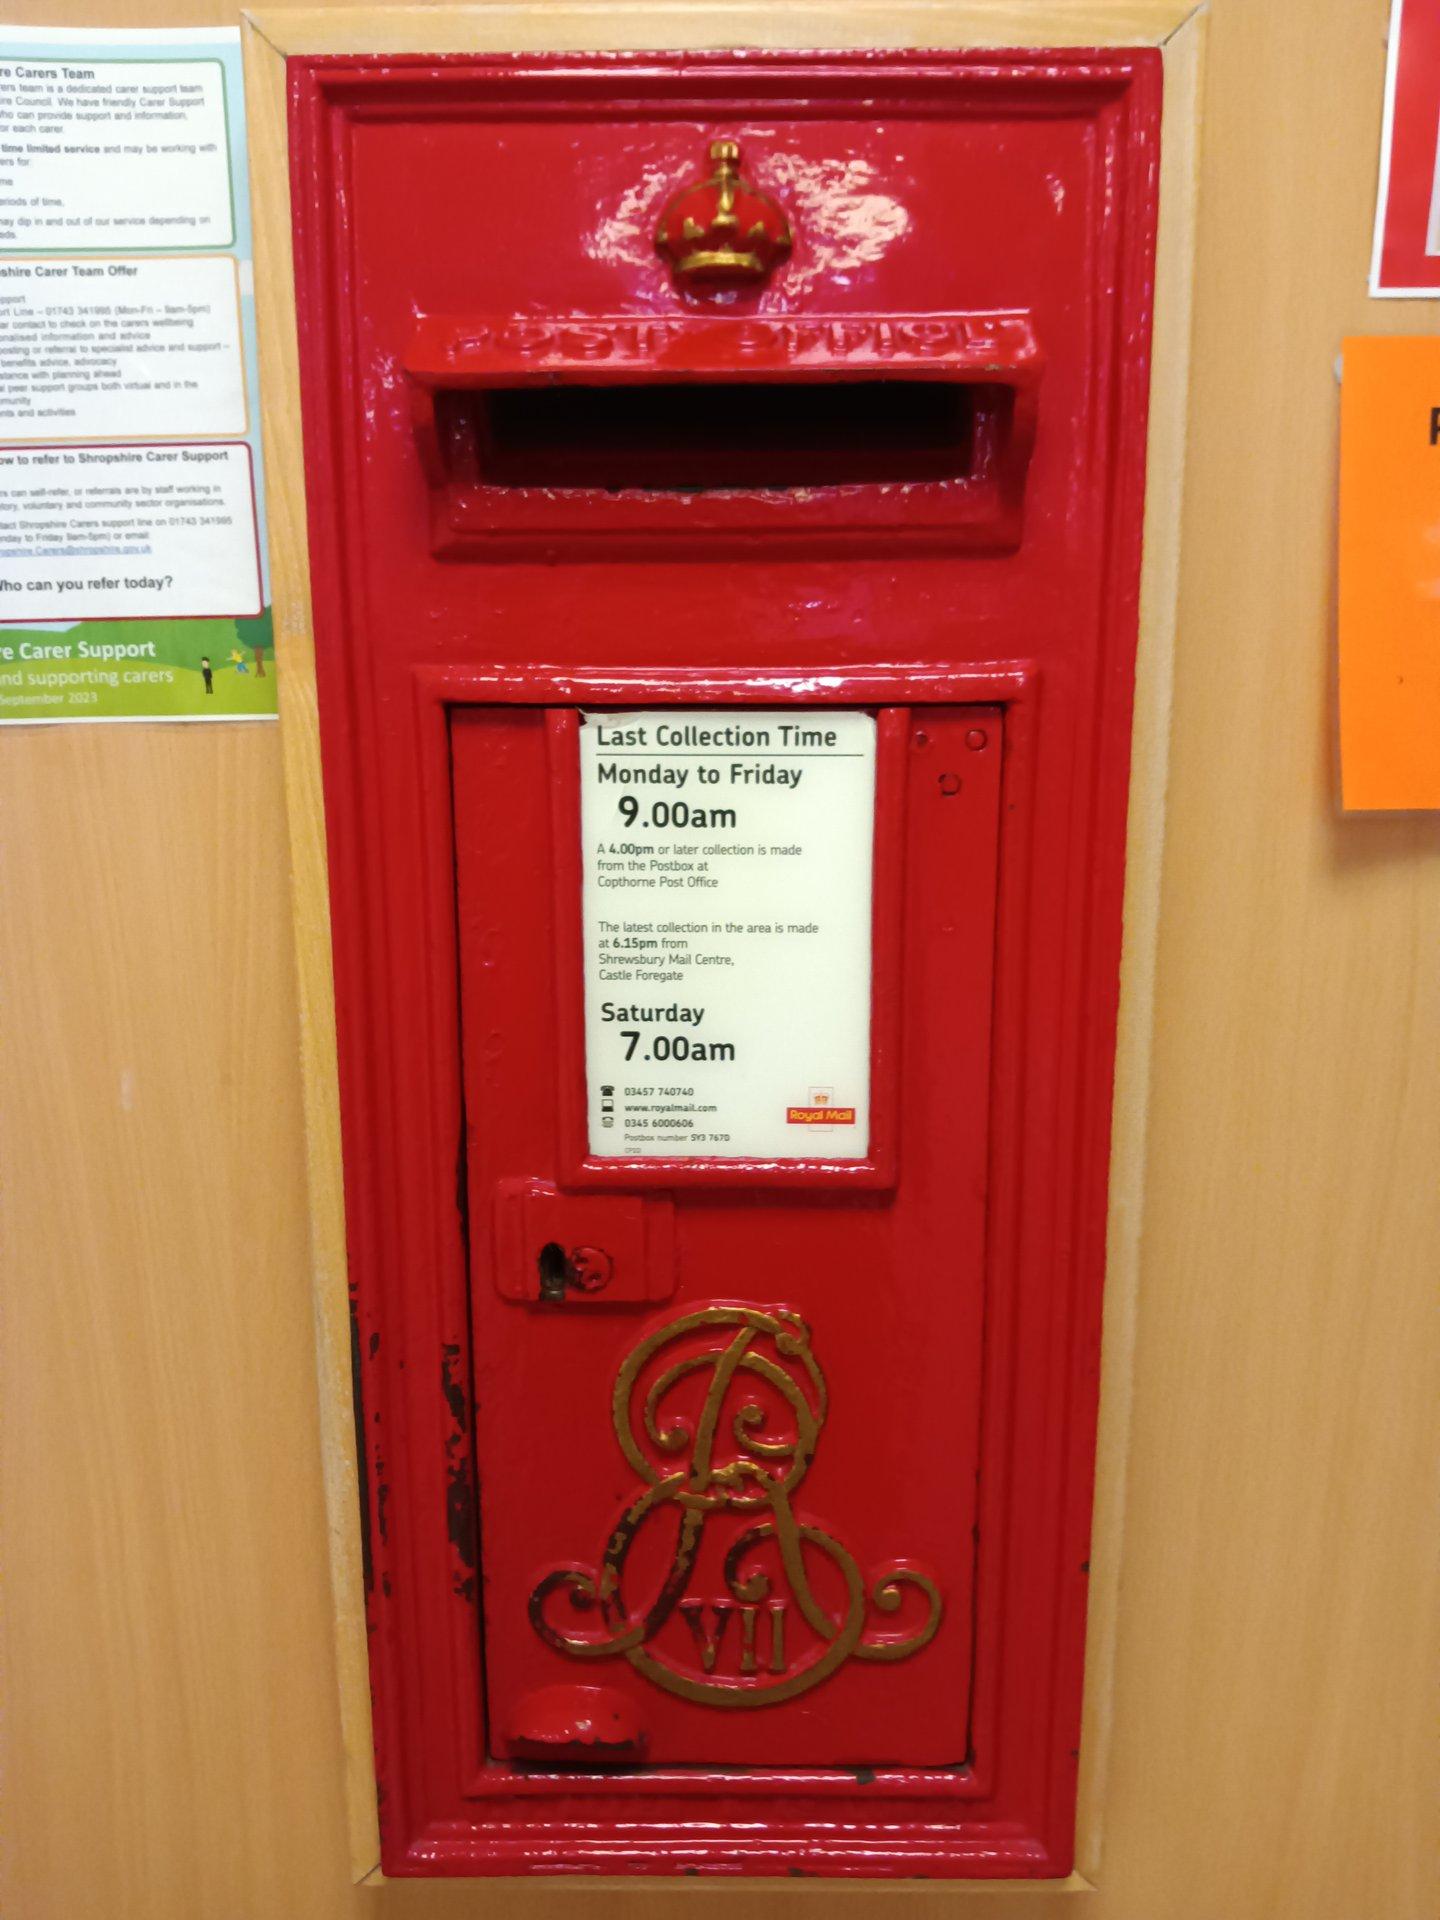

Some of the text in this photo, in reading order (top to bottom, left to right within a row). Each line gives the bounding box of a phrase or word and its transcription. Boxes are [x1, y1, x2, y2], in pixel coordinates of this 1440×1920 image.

[15, 66, 57, 79] Carers
[62, 68, 94, 79] Team
[27, 144, 61, 153] limited
[35, 266, 67, 277] Carer
[72, 266, 104, 277] Team
[108, 265, 137, 276] Offer
[17, 456, 29, 465] to
[32, 454, 59, 465] refer
[63, 454, 75, 464] to
[78, 453, 142, 465] Shropshire
[146, 451, 178, 462] Carer
[182, 451, 228, 463] Support
[26, 581, 52, 591] can
[56, 581, 83, 593] you
[88, 577, 120, 589] refer
[124, 575, 173, 591] today?
[19, 643, 72, 661] Carer
[78, 641, 156, 662] Support
[28, 669, 173, 685] supporting carers
[69, 692, 97, 703] 2023
[598, 726, 836, 746] Last Collection Time
[598, 763, 802, 789] Monday to Friday
[618, 796, 736, 828] 9.00am
[597, 843, 802, 856] A 4.00pm or later collection is made
[597, 859, 708, 871] from the Postbox at
[598, 876, 718, 889] Copthorne Post Office
[598, 921, 819, 933] The latest collection in the area is made
[598, 938, 688, 950] at 6.15pm from
[599, 953, 734, 967] Shrewsbury Mail Centre,
[599, 969, 683, 983] Castle Foregate
[601, 1002, 704, 1026] Saturday
[620, 1031, 734, 1061] 7.00am
[624, 1088, 694, 1096] 03457 740740
[624, 1104, 717, 1113] www.royalmail.com
[790, 1110, 851, 1122] Royal Mail
[625, 1119, 693, 1127] 0345 6000606
[679, 1603, 785, 1674] VII
